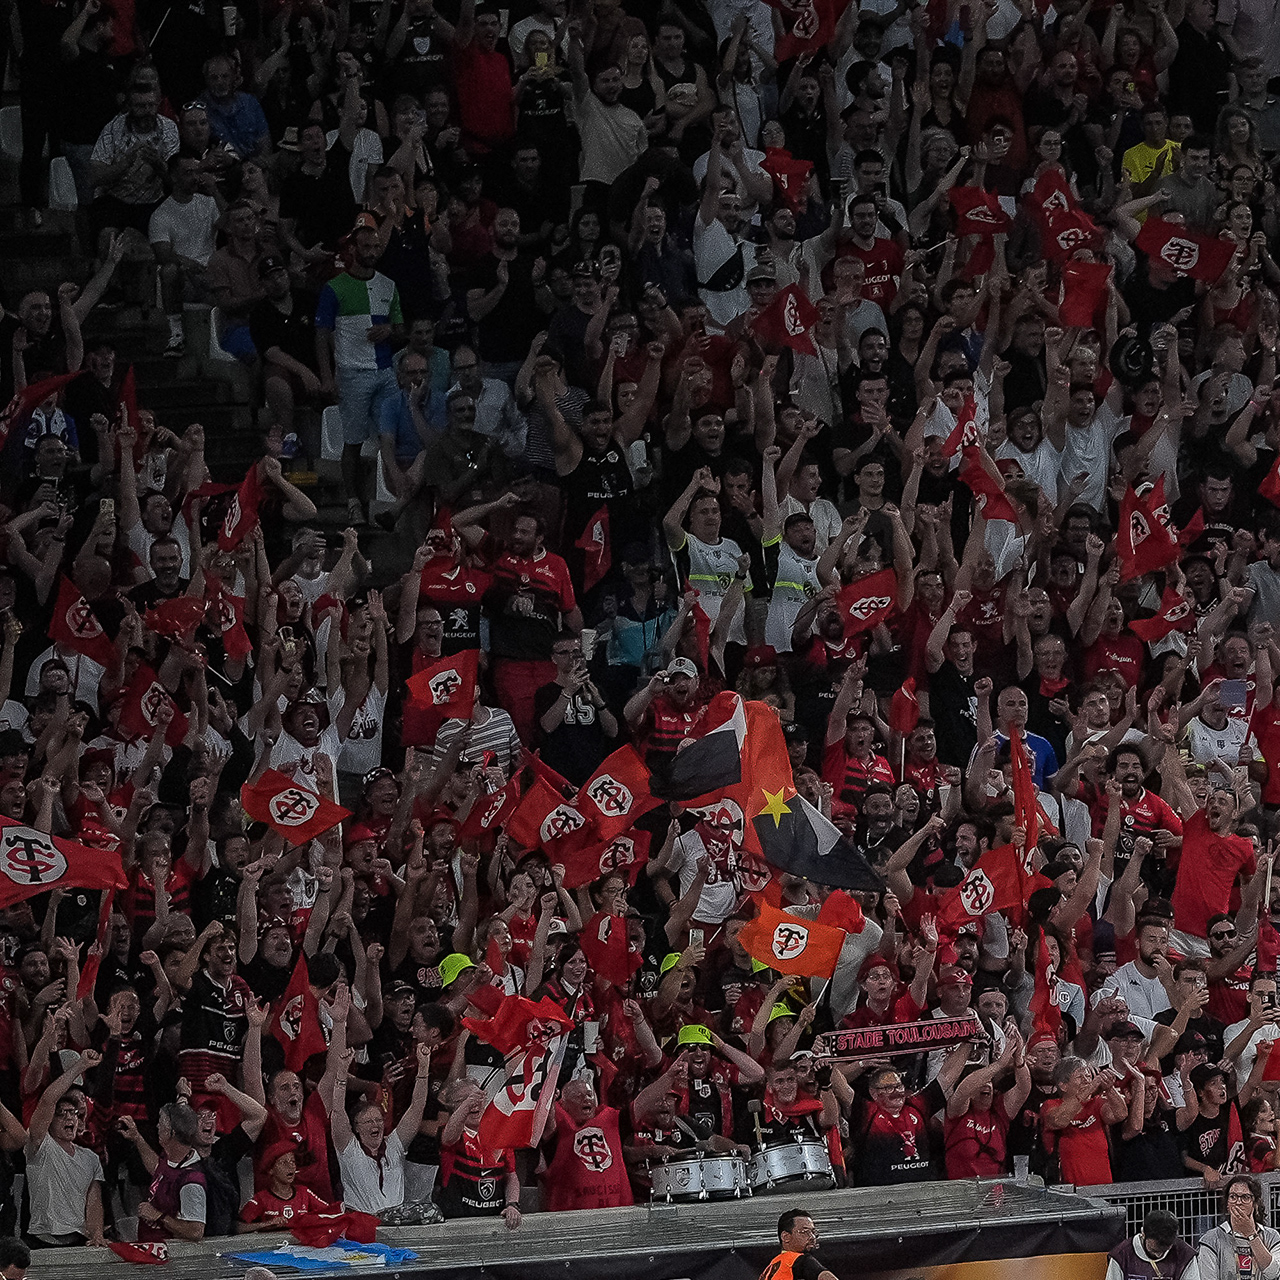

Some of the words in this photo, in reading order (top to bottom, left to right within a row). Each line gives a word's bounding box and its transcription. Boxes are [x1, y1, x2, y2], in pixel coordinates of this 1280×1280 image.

[837, 1030, 885, 1052] STADE
[888, 1019, 977, 1046] TOULOUSAIN
[890, 1160, 930, 1171] PEUGEOT
